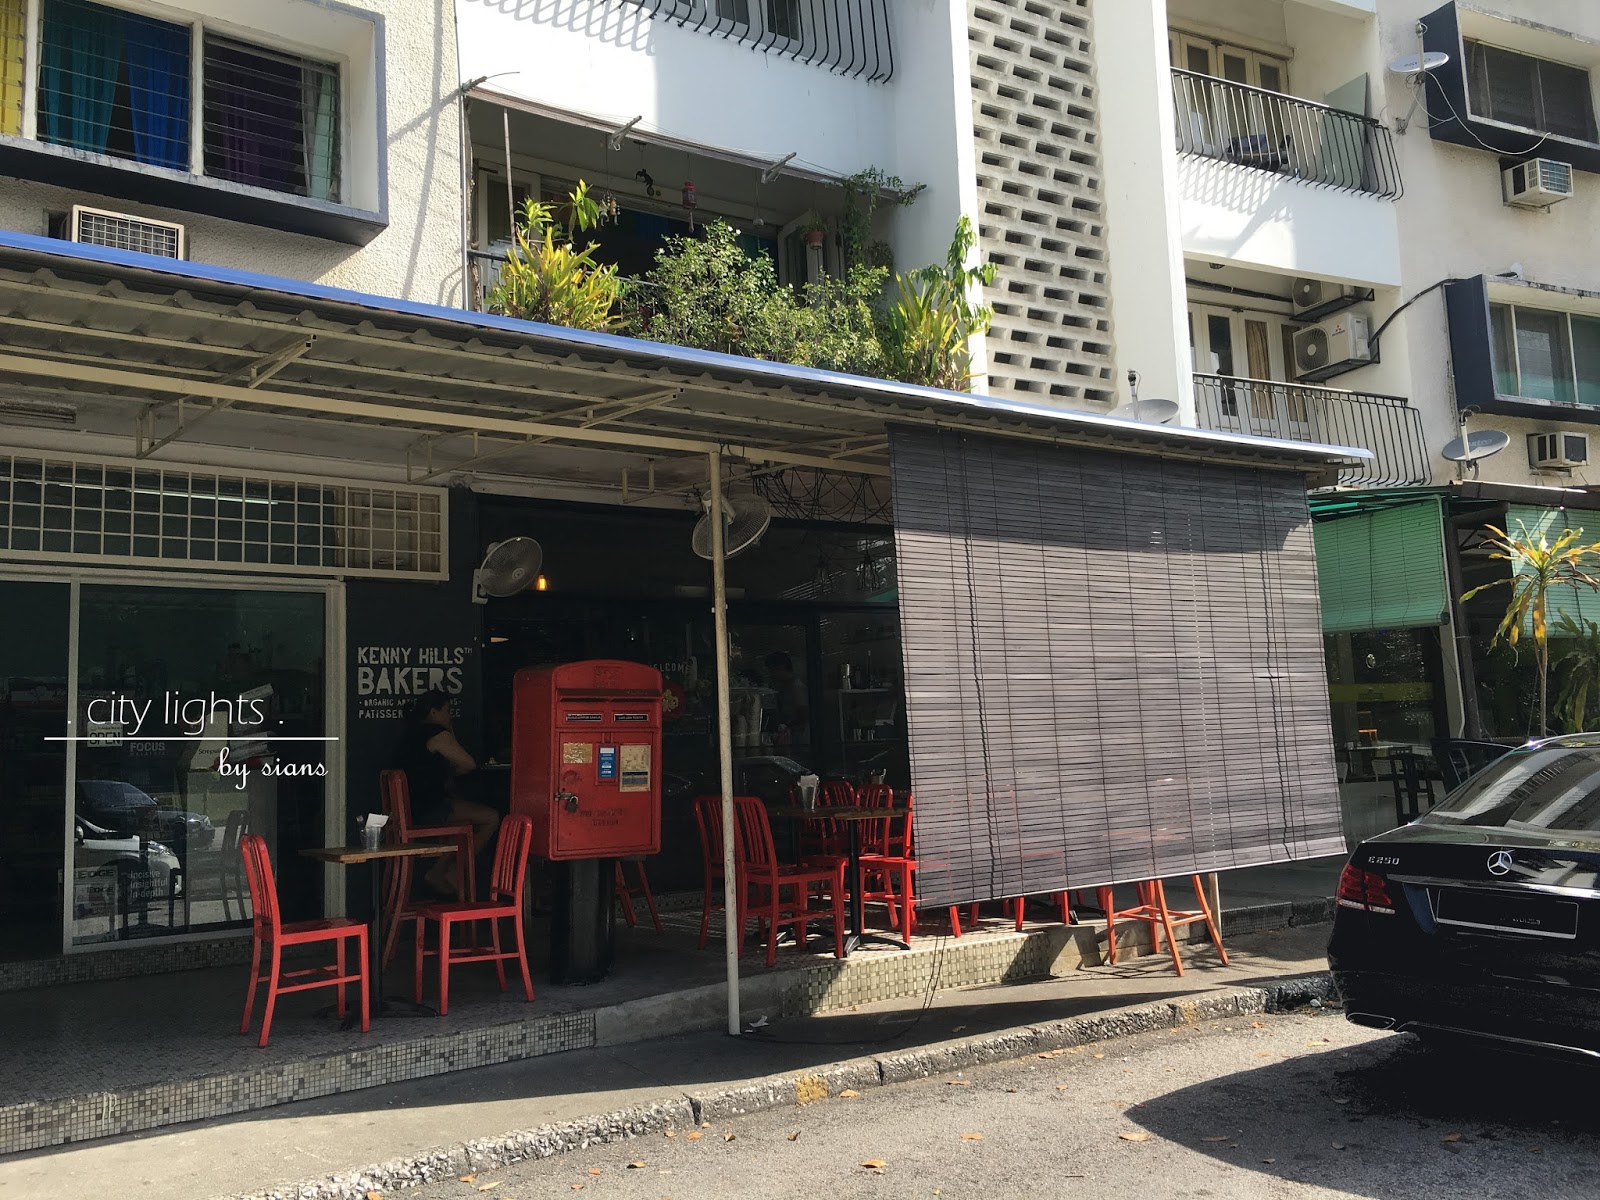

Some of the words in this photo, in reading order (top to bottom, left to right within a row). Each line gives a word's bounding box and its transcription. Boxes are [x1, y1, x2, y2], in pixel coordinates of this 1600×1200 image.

[357, 646, 412, 665] KENNY
[357, 666, 464, 696] BAKERS
[363, 698, 395, 707] ORGANIC
[89, 731, 121, 745] OPEN
[129, 742, 166, 752] FOCUS
[1367, 855, 1400, 866] E250
[130, 870, 161, 879] Incisive
[130, 879, 168, 889] Insightful
[130, 888, 164, 898] In-depth
